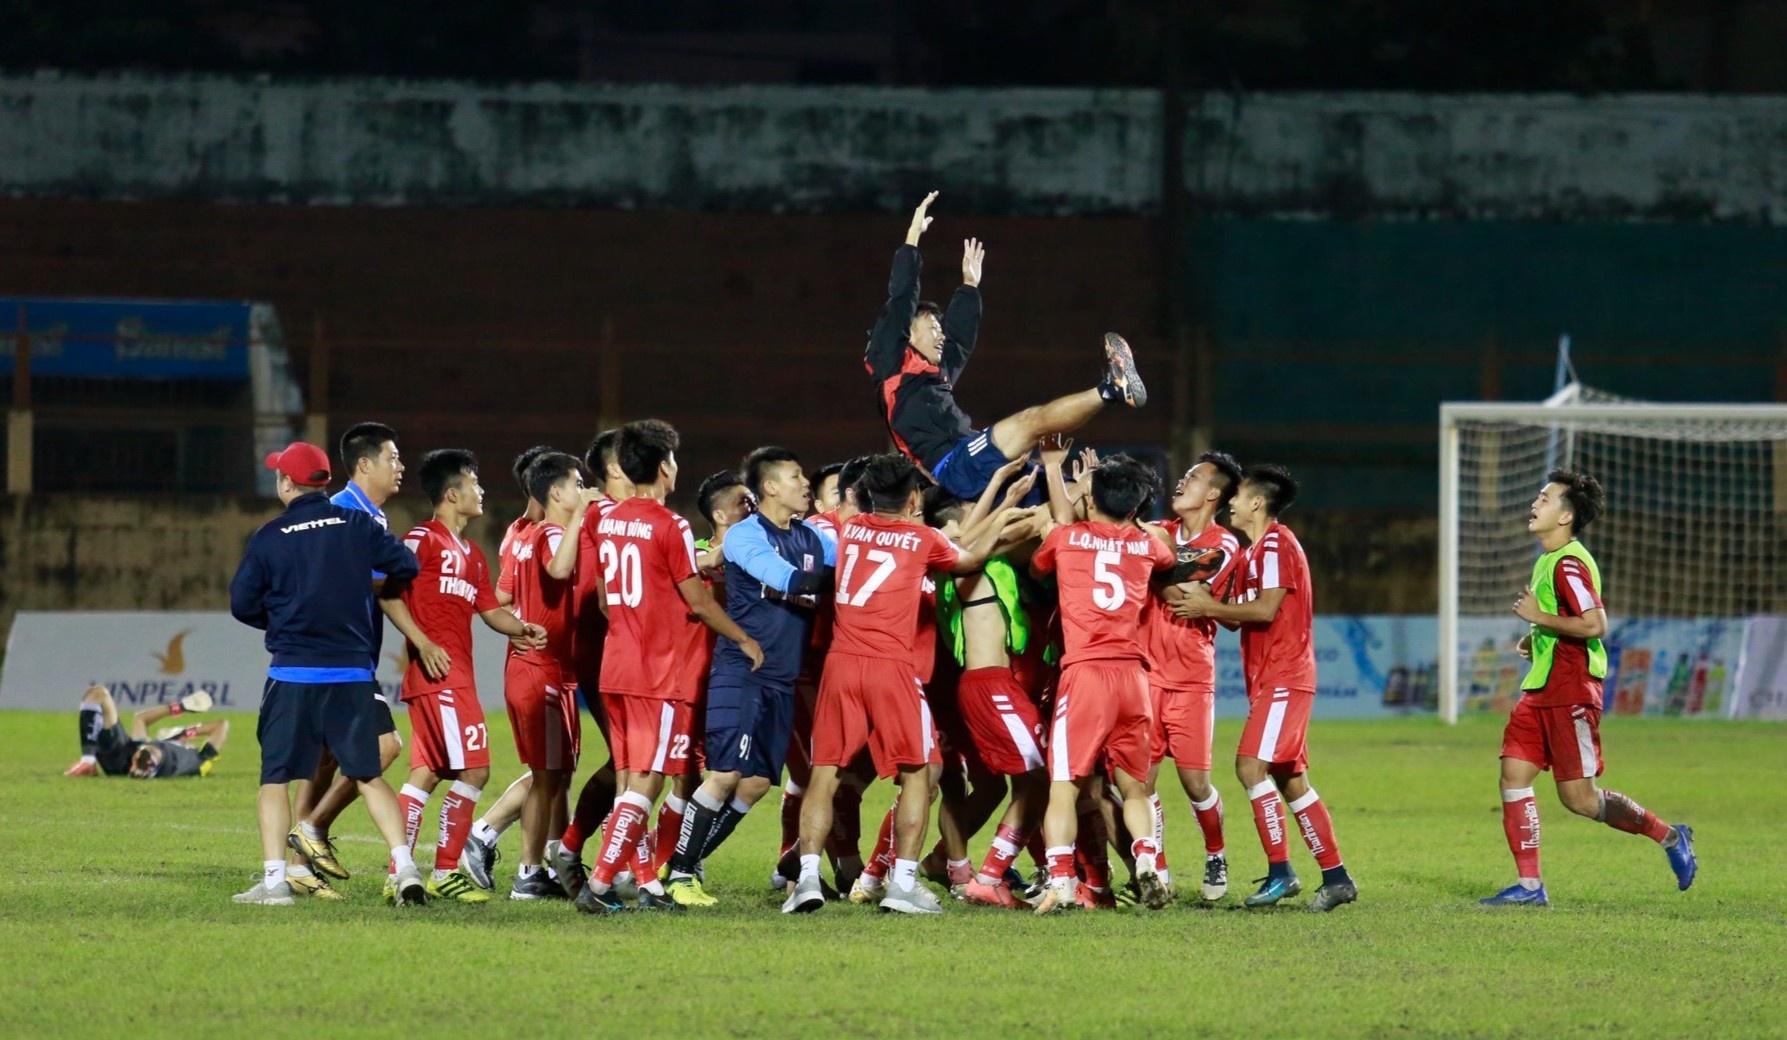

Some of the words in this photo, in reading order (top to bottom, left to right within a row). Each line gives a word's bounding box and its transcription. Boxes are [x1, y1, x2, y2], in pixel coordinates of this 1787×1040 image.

[280, 517, 347, 534] VIETTEL
[875, 531, 922, 552] QUYẾT
[440, 549, 461, 575] 27
[599, 539, 643, 609] 20
[835, 543, 897, 607] 17
[1092, 549, 1126, 611] 5
[464, 722, 488, 751] 27
[669, 733, 691, 760] 22
